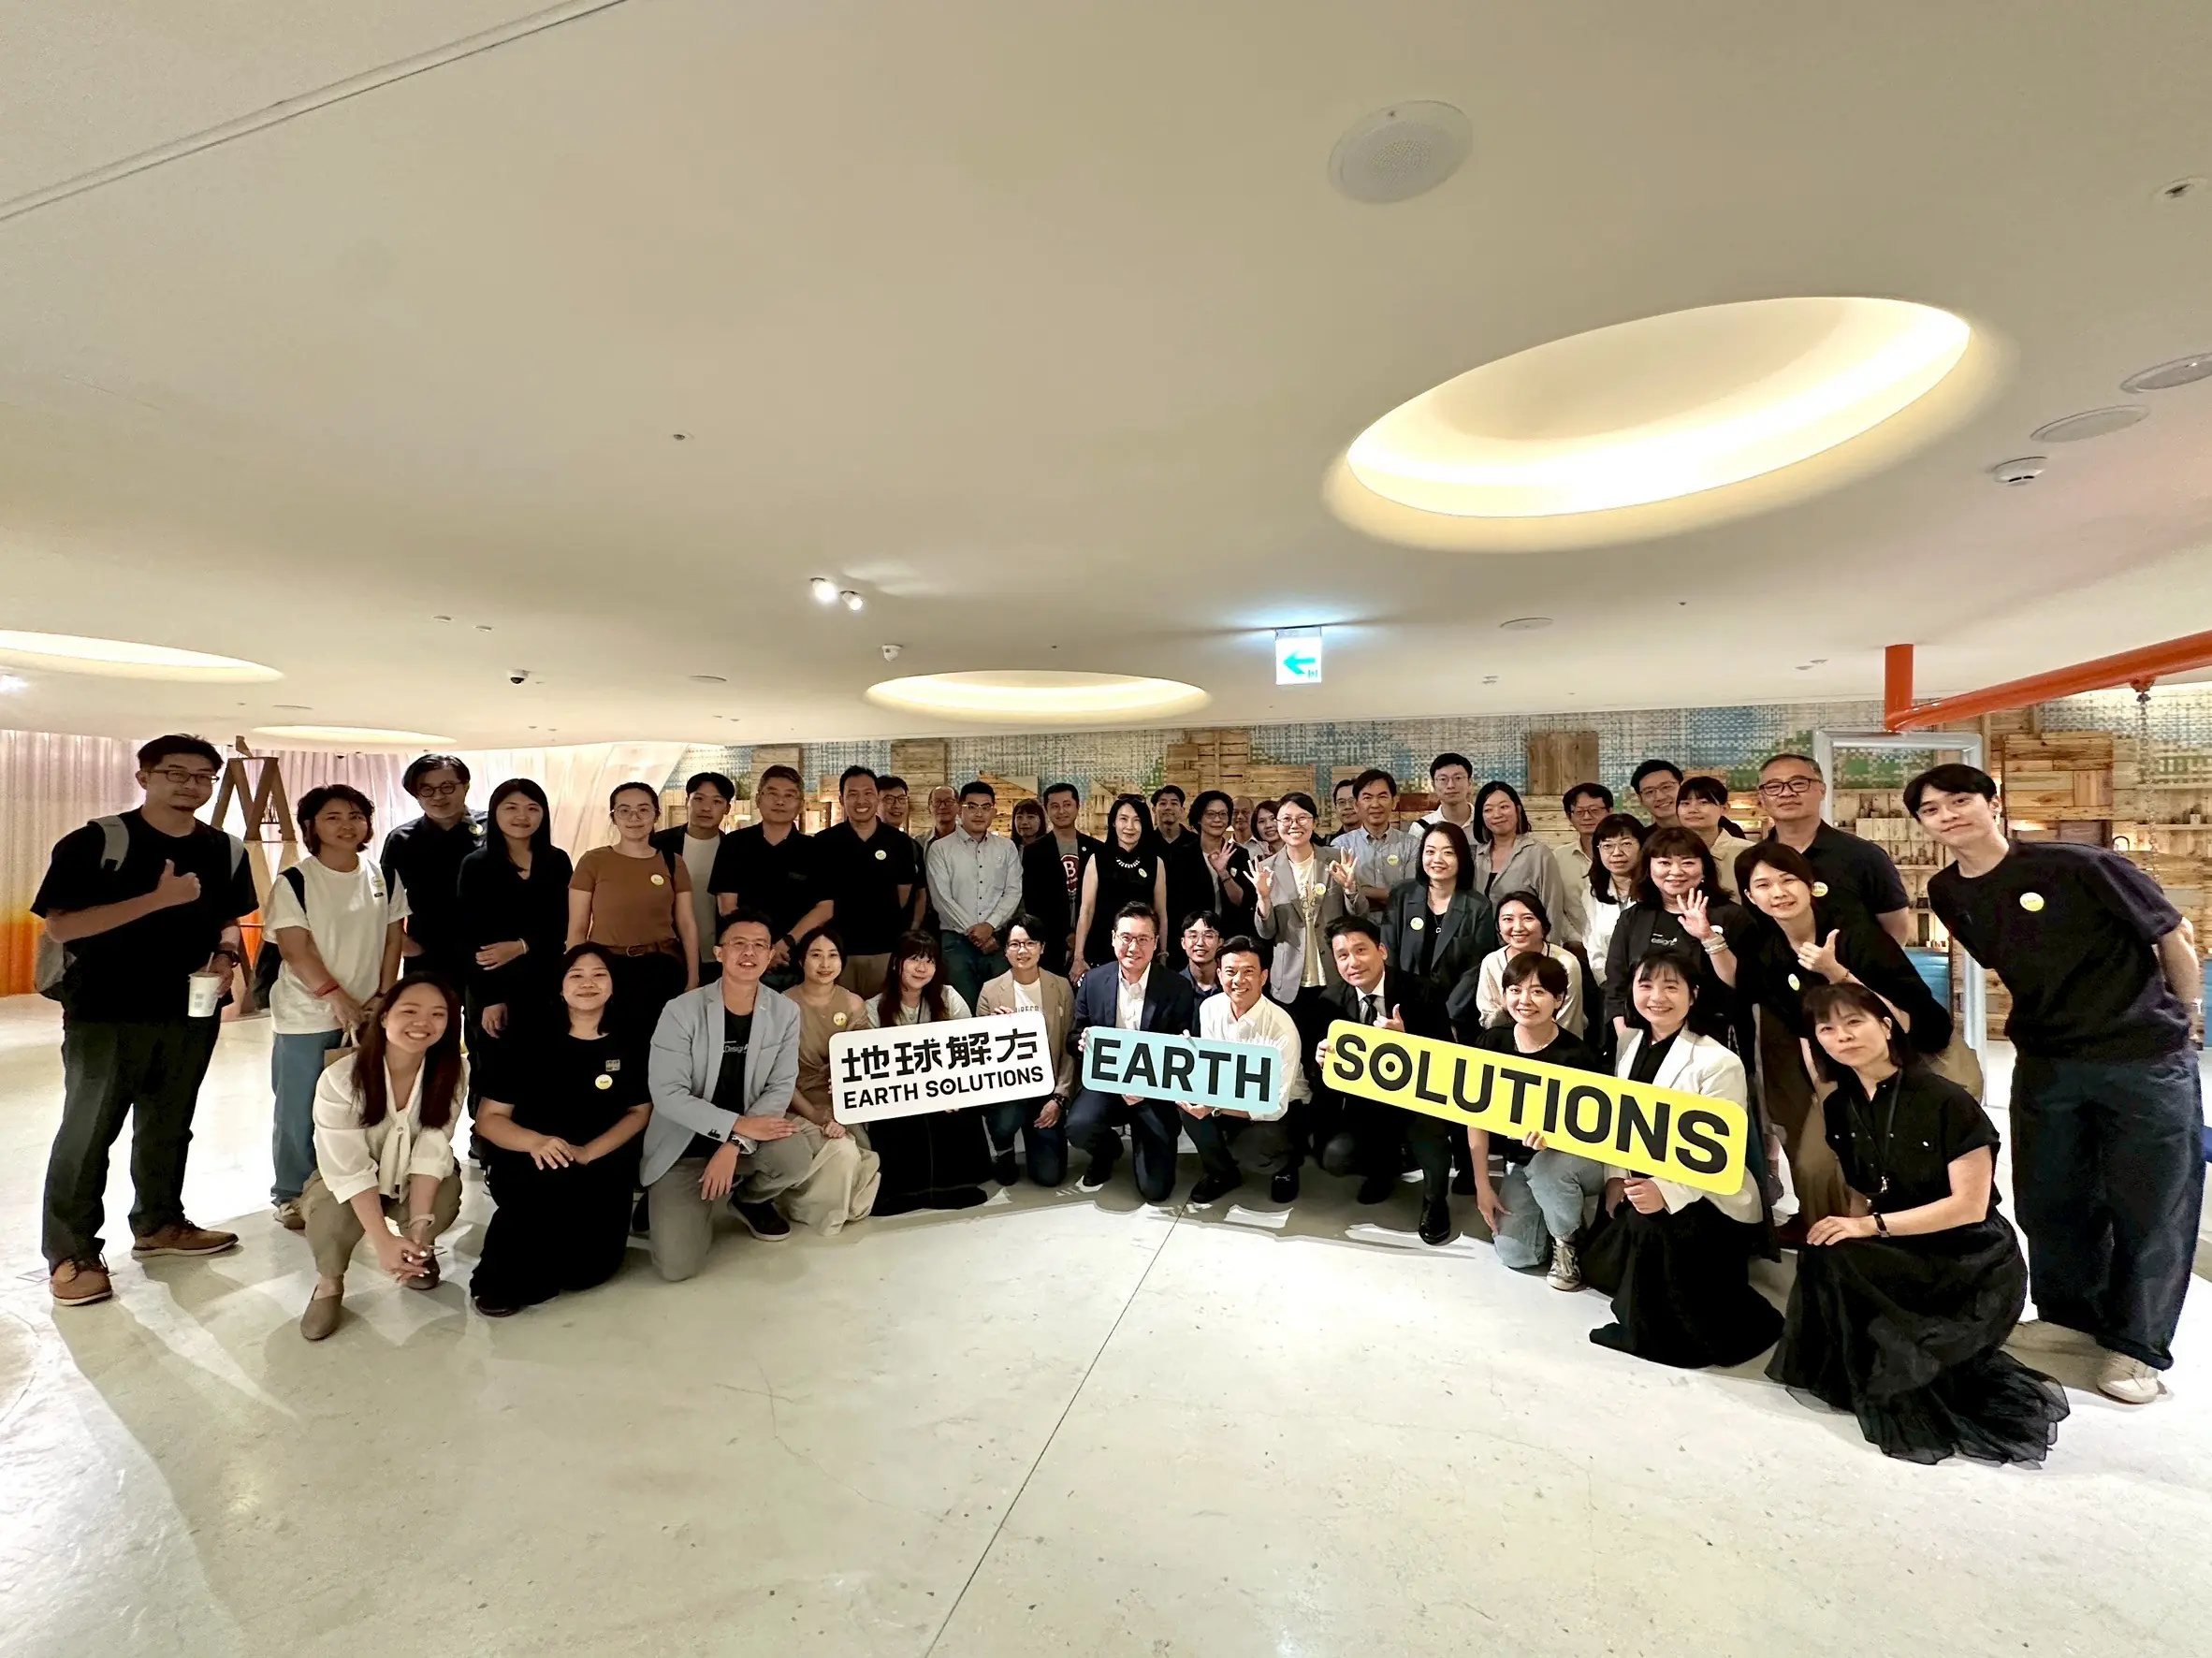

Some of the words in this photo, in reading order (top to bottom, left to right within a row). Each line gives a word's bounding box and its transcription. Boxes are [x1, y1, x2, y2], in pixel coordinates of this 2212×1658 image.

[841, 1028, 1038, 1084] 地球解方
[1091, 1038, 1272, 1102] EARTH
[843, 1083, 919, 1110] EARTH
[925, 1066, 1044, 1098] SOLUTIONS
[1332, 1033, 1730, 1174] SOLUTIONS
